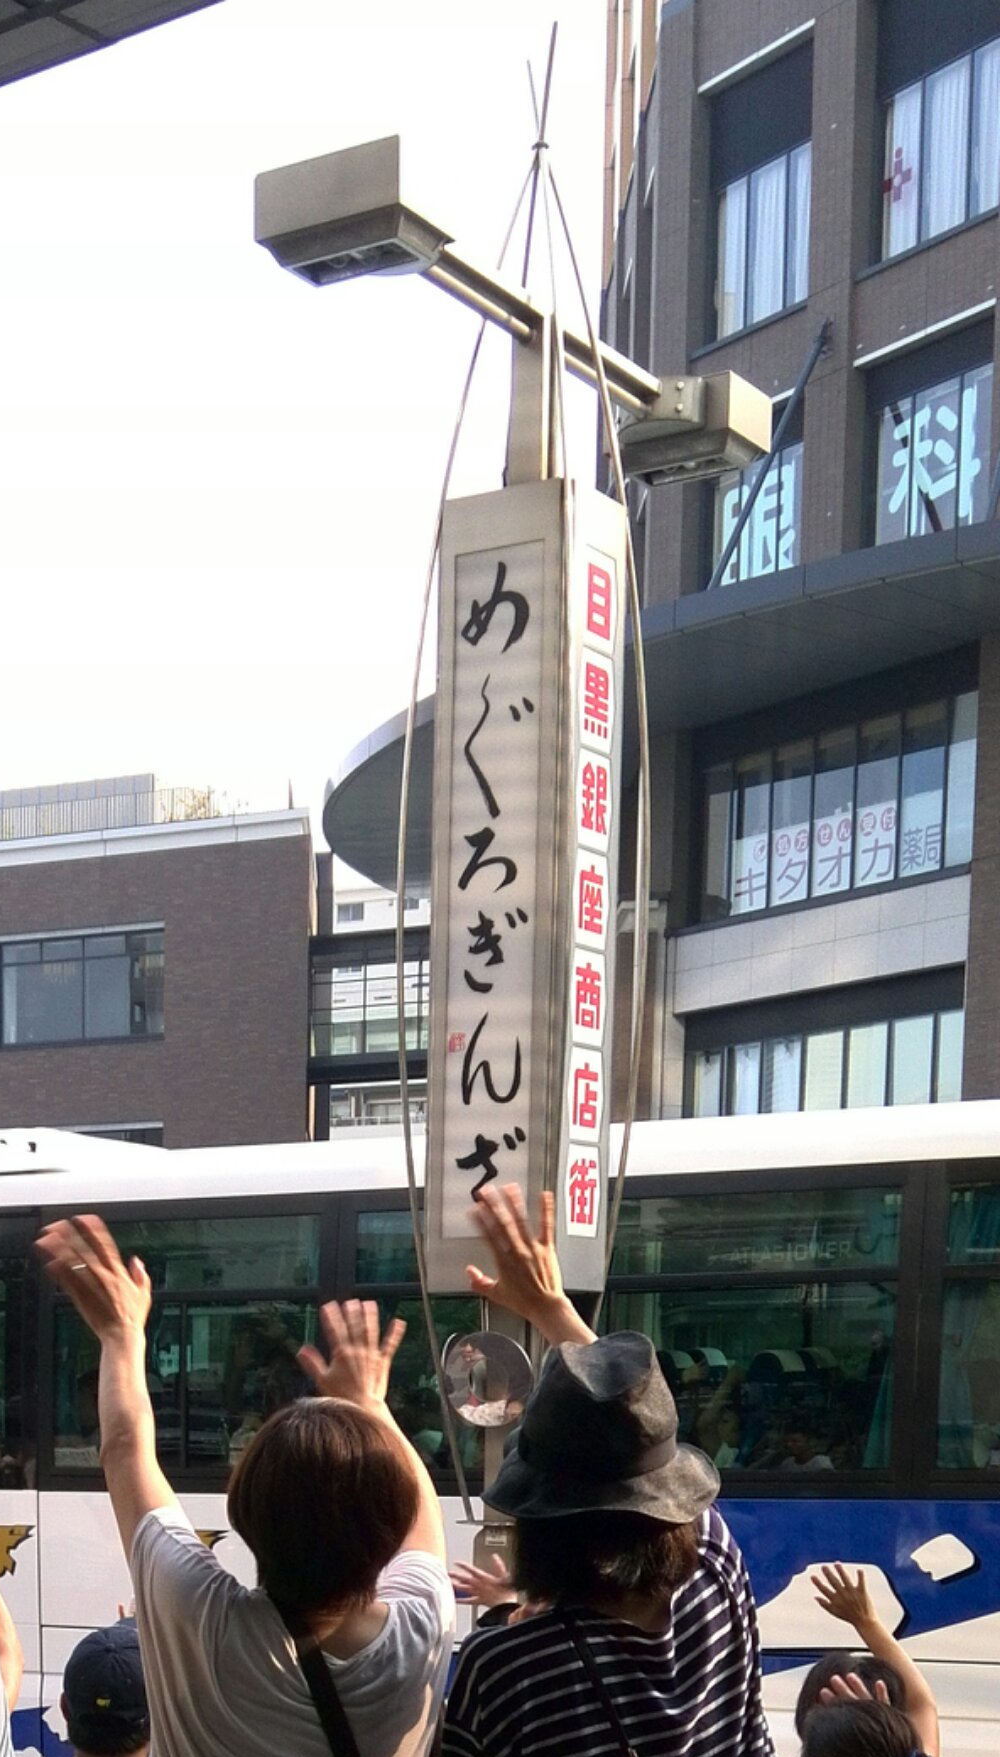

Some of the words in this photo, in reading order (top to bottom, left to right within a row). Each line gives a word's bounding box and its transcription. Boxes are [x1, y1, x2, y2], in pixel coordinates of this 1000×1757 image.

[721, 387, 981, 586] 眼科
[456, 562, 535, 1201] めぐろぎんざ
[569, 562, 611, 1225] 目黒銀座商店街
[734, 823, 941, 906] キタオカ薬局
